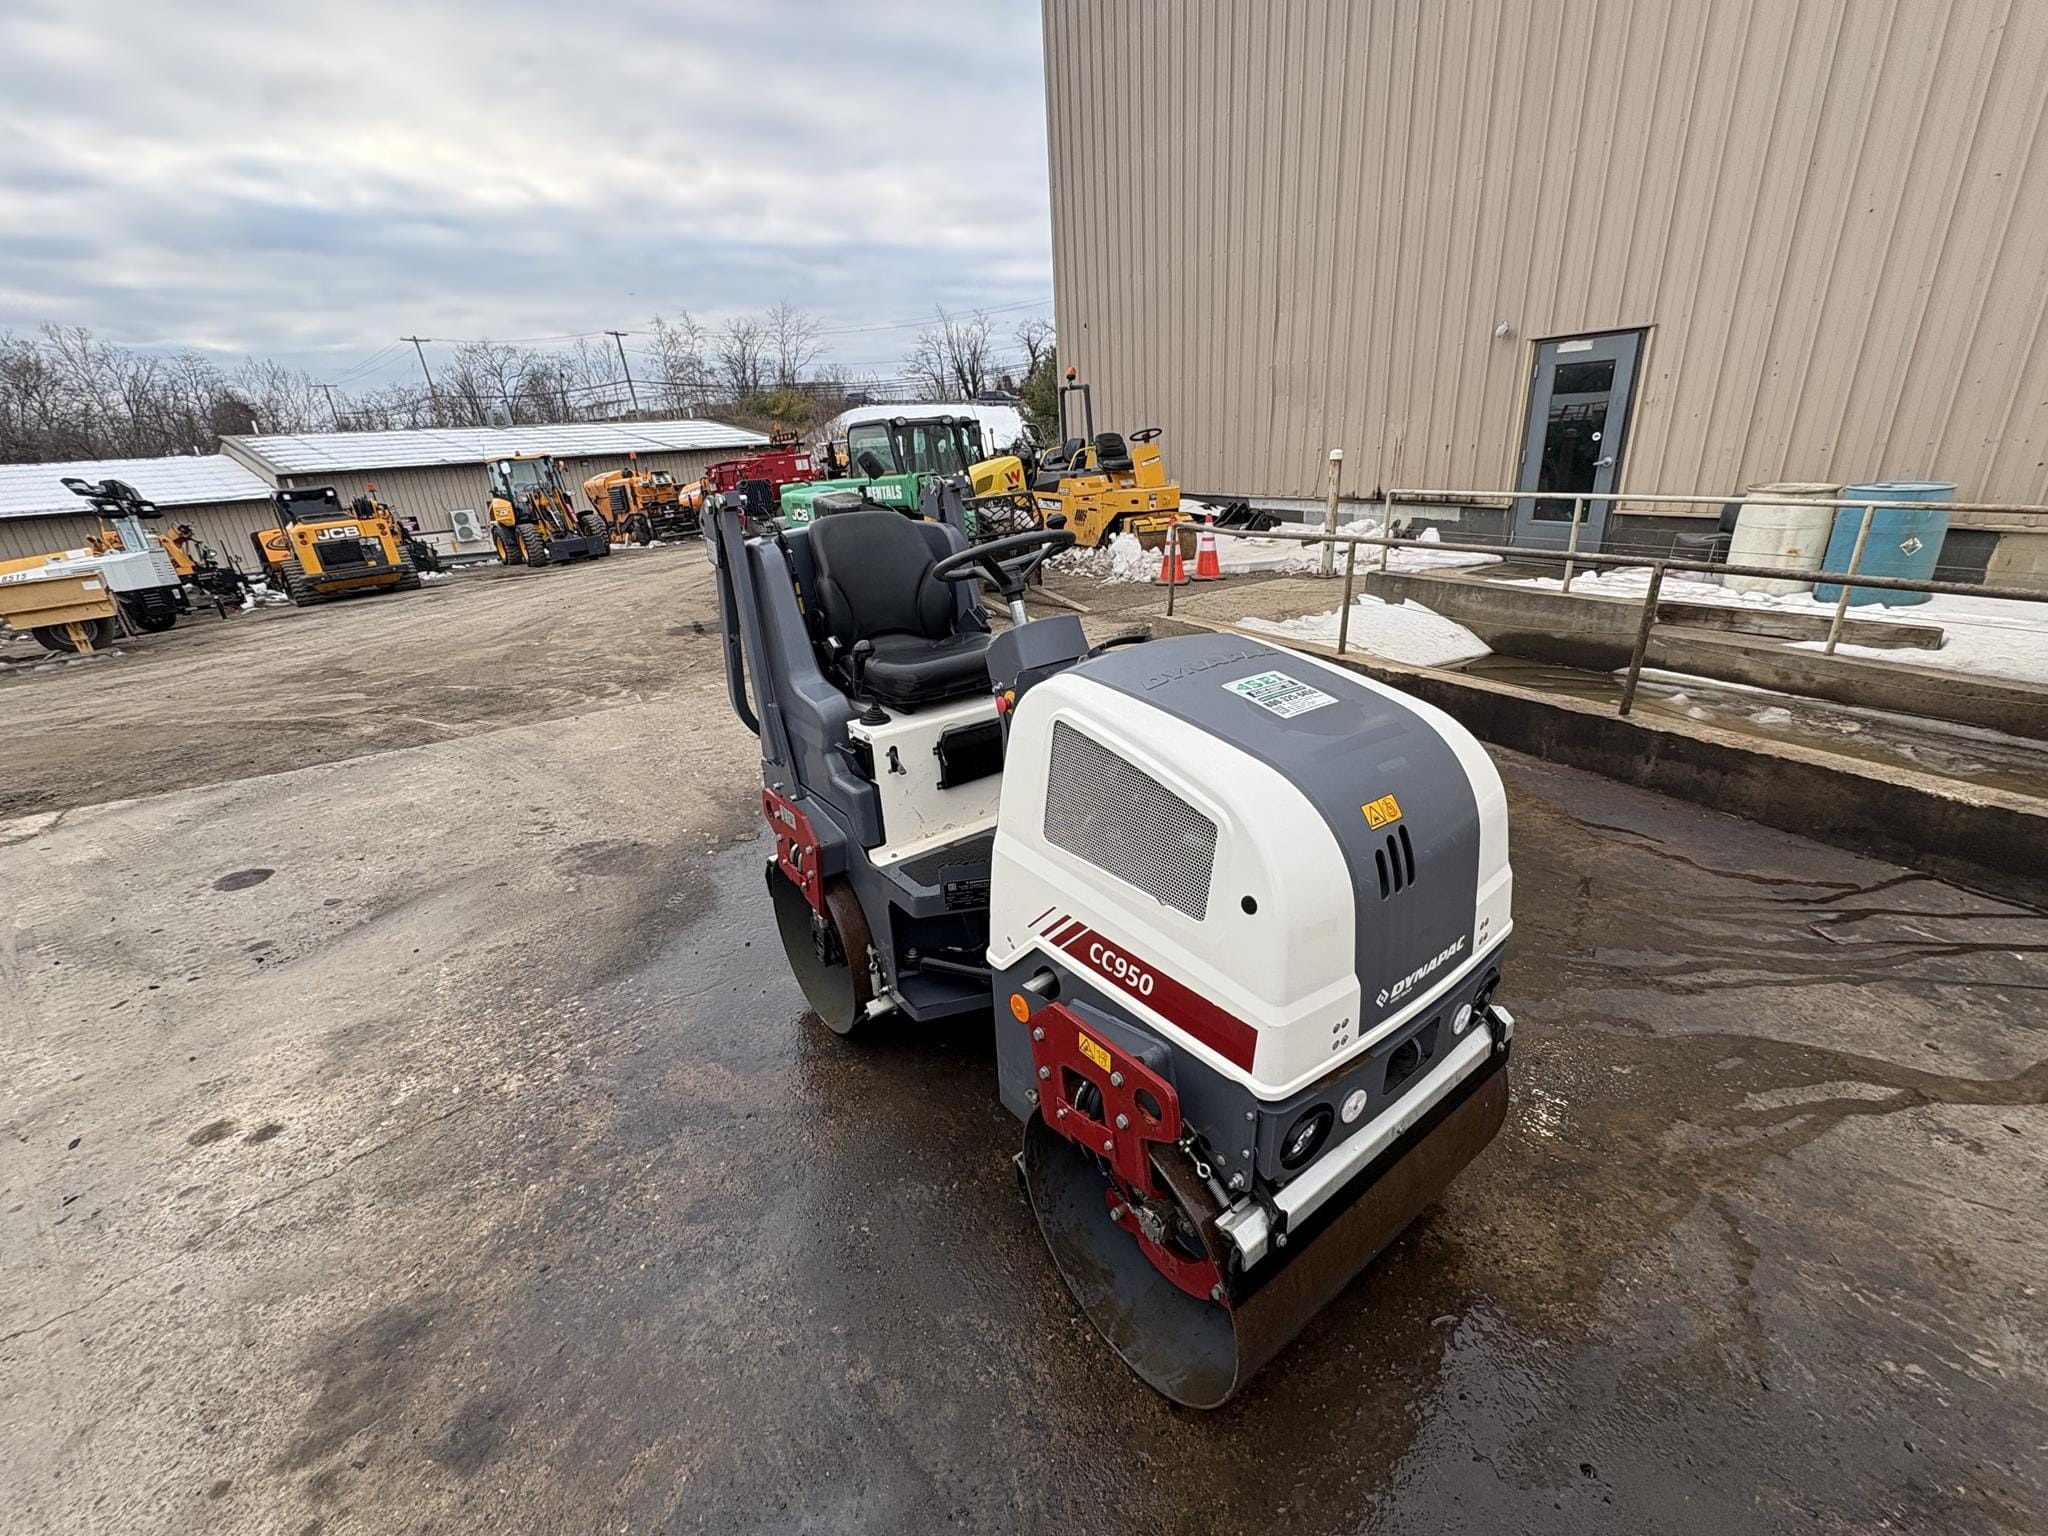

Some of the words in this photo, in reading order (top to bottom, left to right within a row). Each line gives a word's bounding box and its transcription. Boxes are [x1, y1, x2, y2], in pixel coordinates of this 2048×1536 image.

[866, 485, 902, 501] RENTALS
[792, 508, 809, 521] JCB
[318, 526, 360, 540] JCB
[1089, 942, 1154, 996] CC950
[1390, 934, 1466, 999] DYNAPAC
